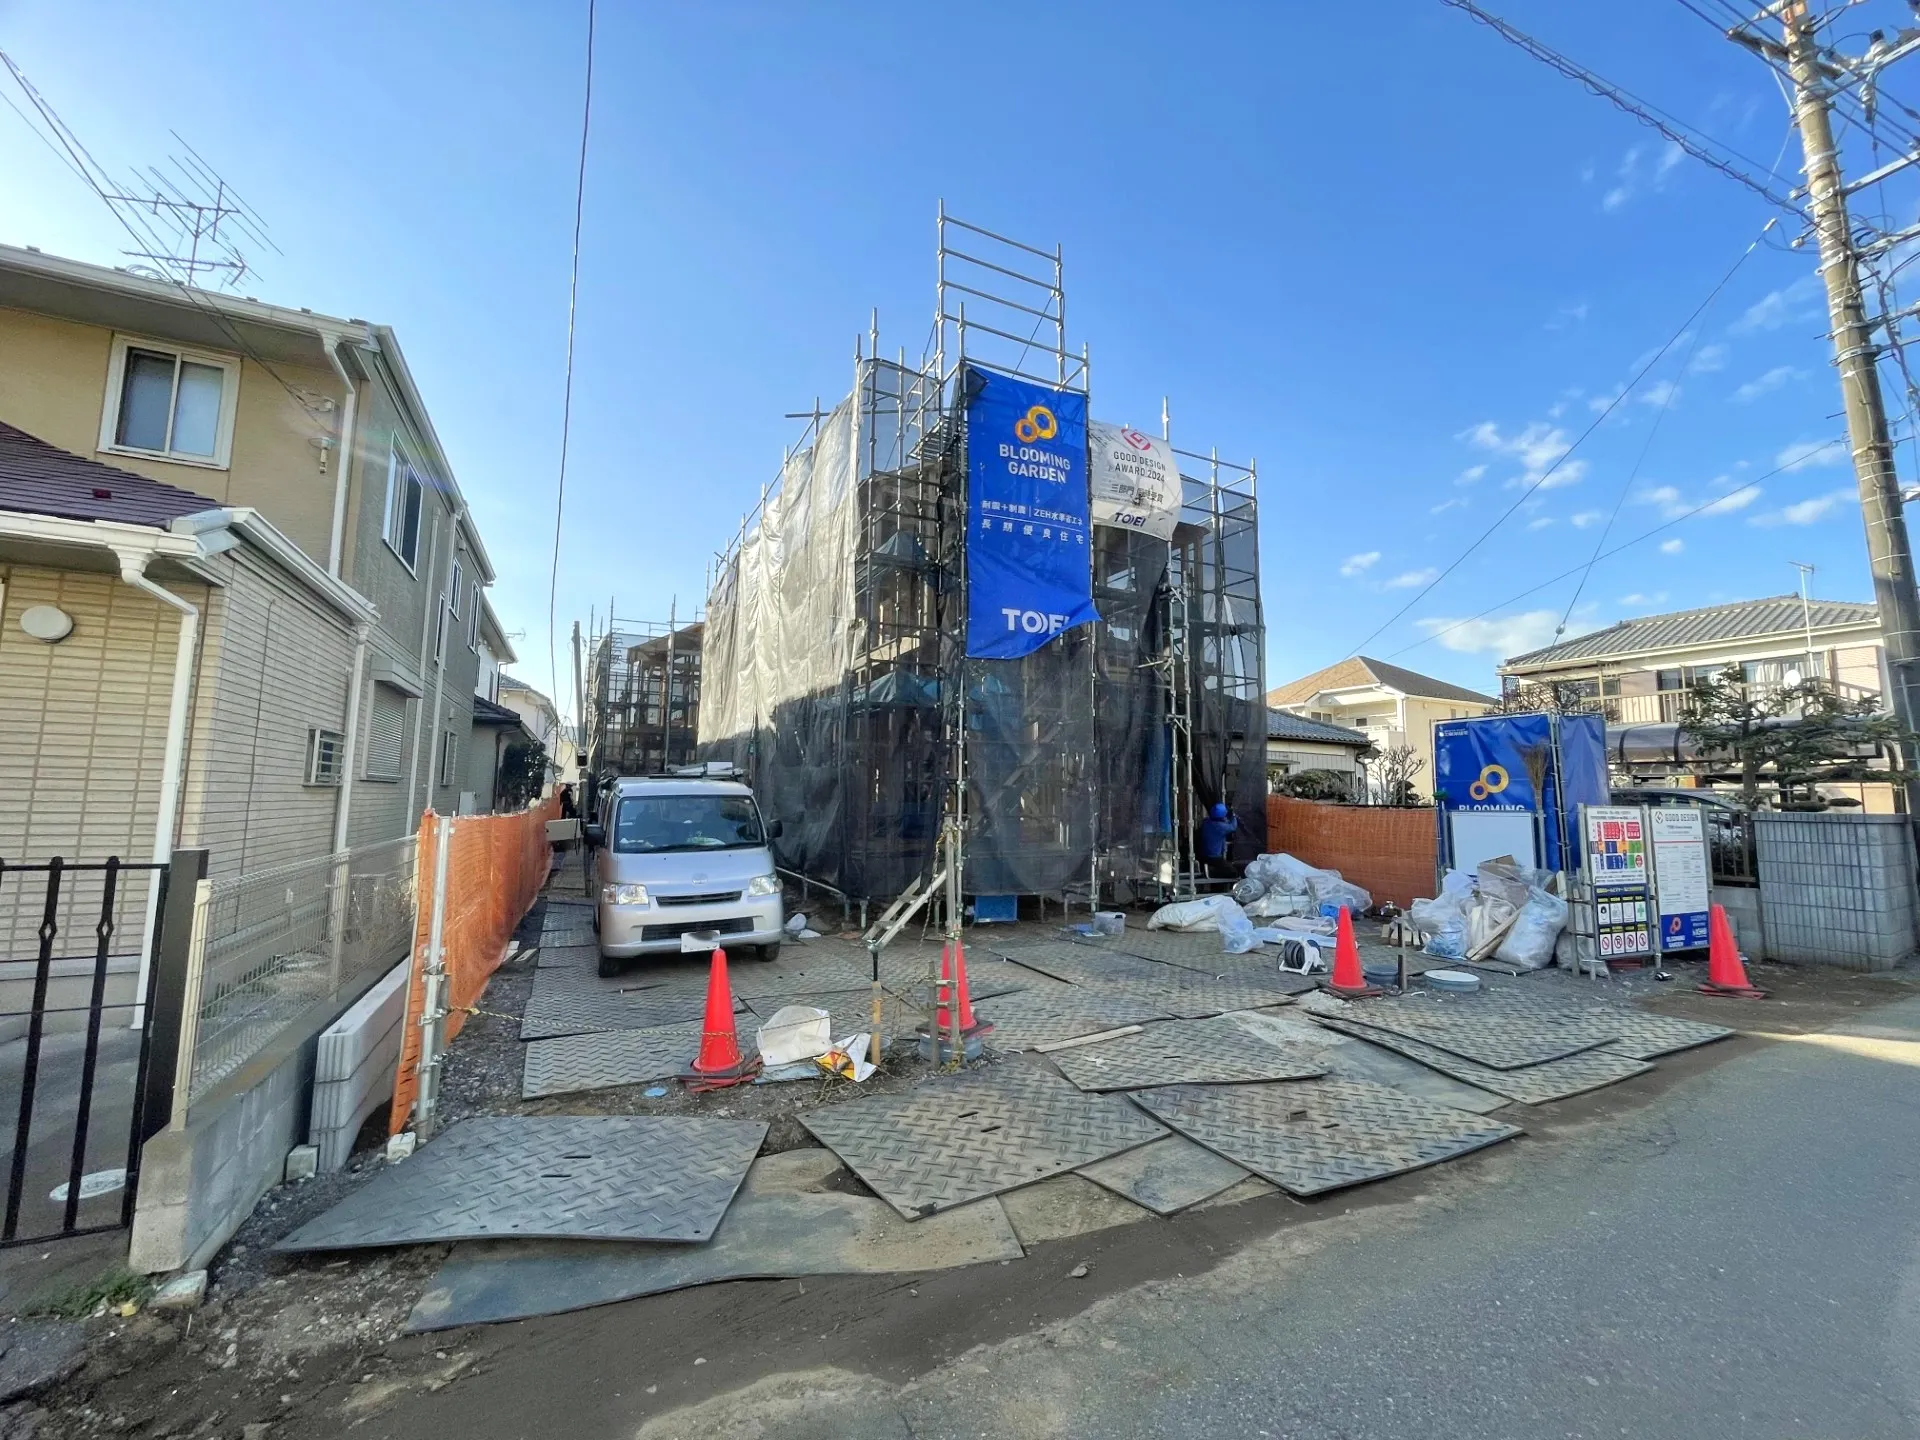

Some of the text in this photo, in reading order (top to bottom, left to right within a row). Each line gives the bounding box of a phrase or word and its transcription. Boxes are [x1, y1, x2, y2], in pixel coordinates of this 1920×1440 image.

[999, 444, 1071, 470] BLOOMING
[1113, 451, 1166, 472] GOOD DESIGN
[1008, 461, 1066, 484] GARDEN
[1114, 463, 1165, 483] AWARD 2024
[1113, 512, 1146, 527] TOEI
[982, 518, 1084, 545] 長期優良住宅
[1664, 813, 1699, 822] GOOD DESIGN
